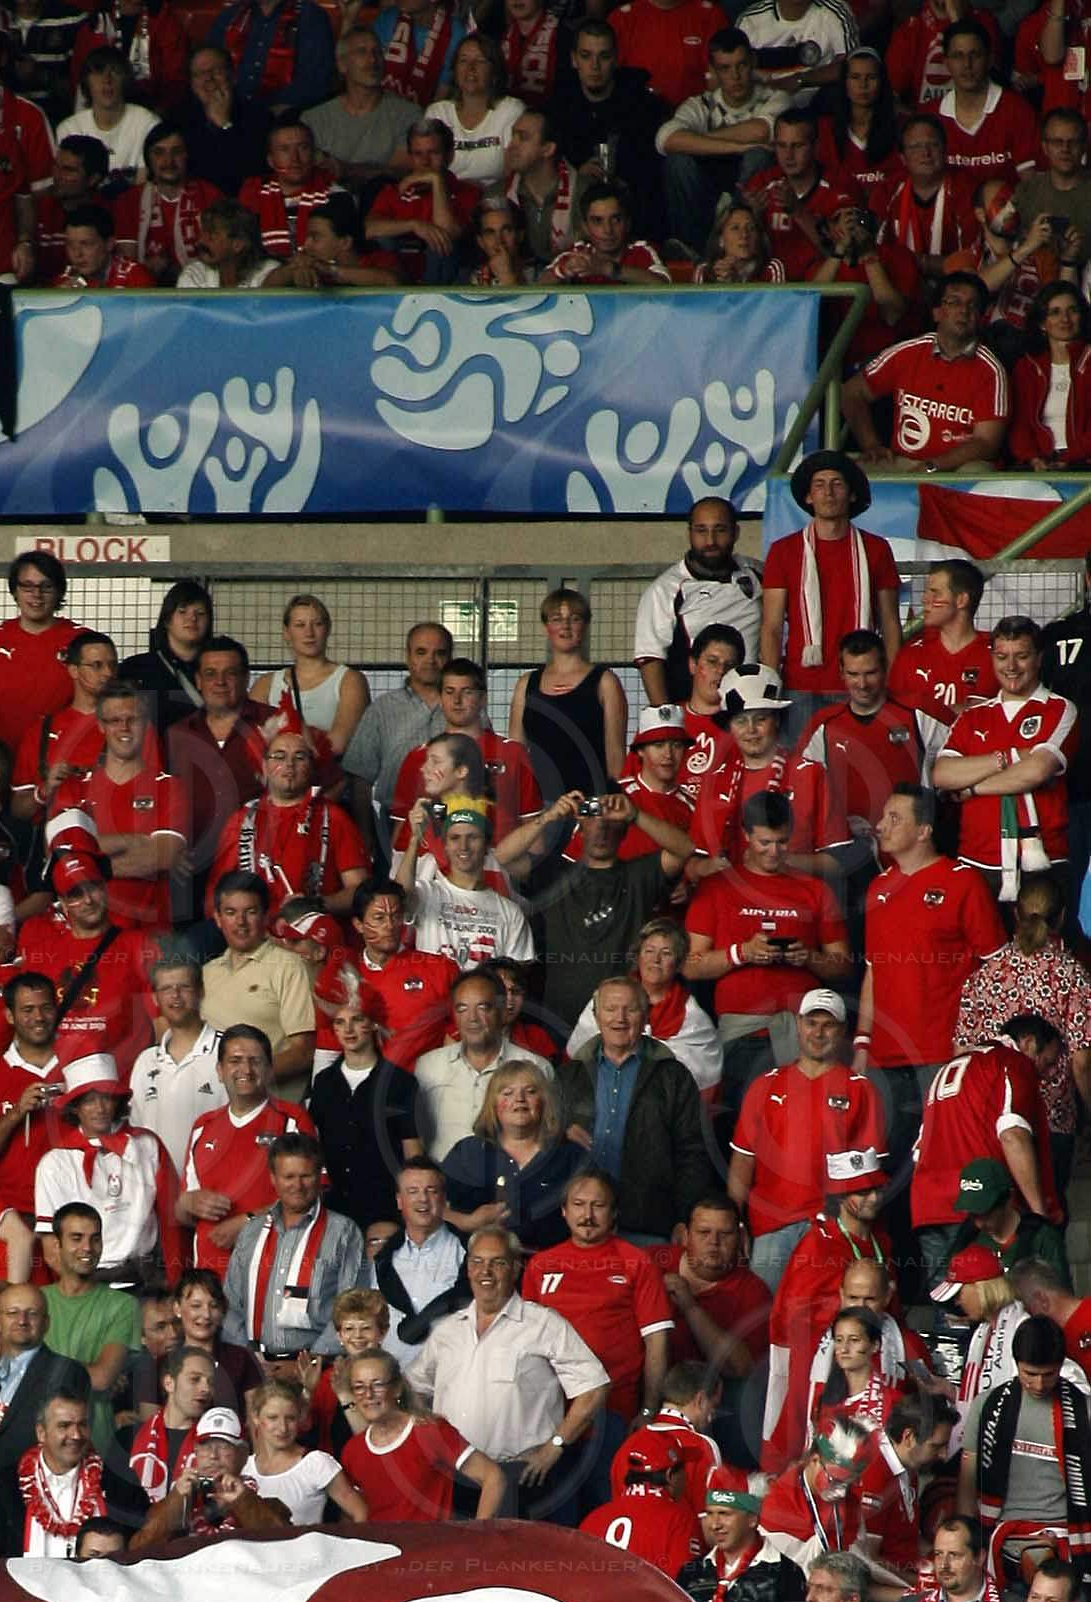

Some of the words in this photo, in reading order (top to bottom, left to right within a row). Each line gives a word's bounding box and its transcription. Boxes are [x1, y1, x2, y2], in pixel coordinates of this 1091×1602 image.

[31, 539, 147, 563] BLOCK
[1056, 639, 1080, 666] 17
[741, 908, 798, 919] AUSTRIA
[927, 1056, 970, 1107] 10
